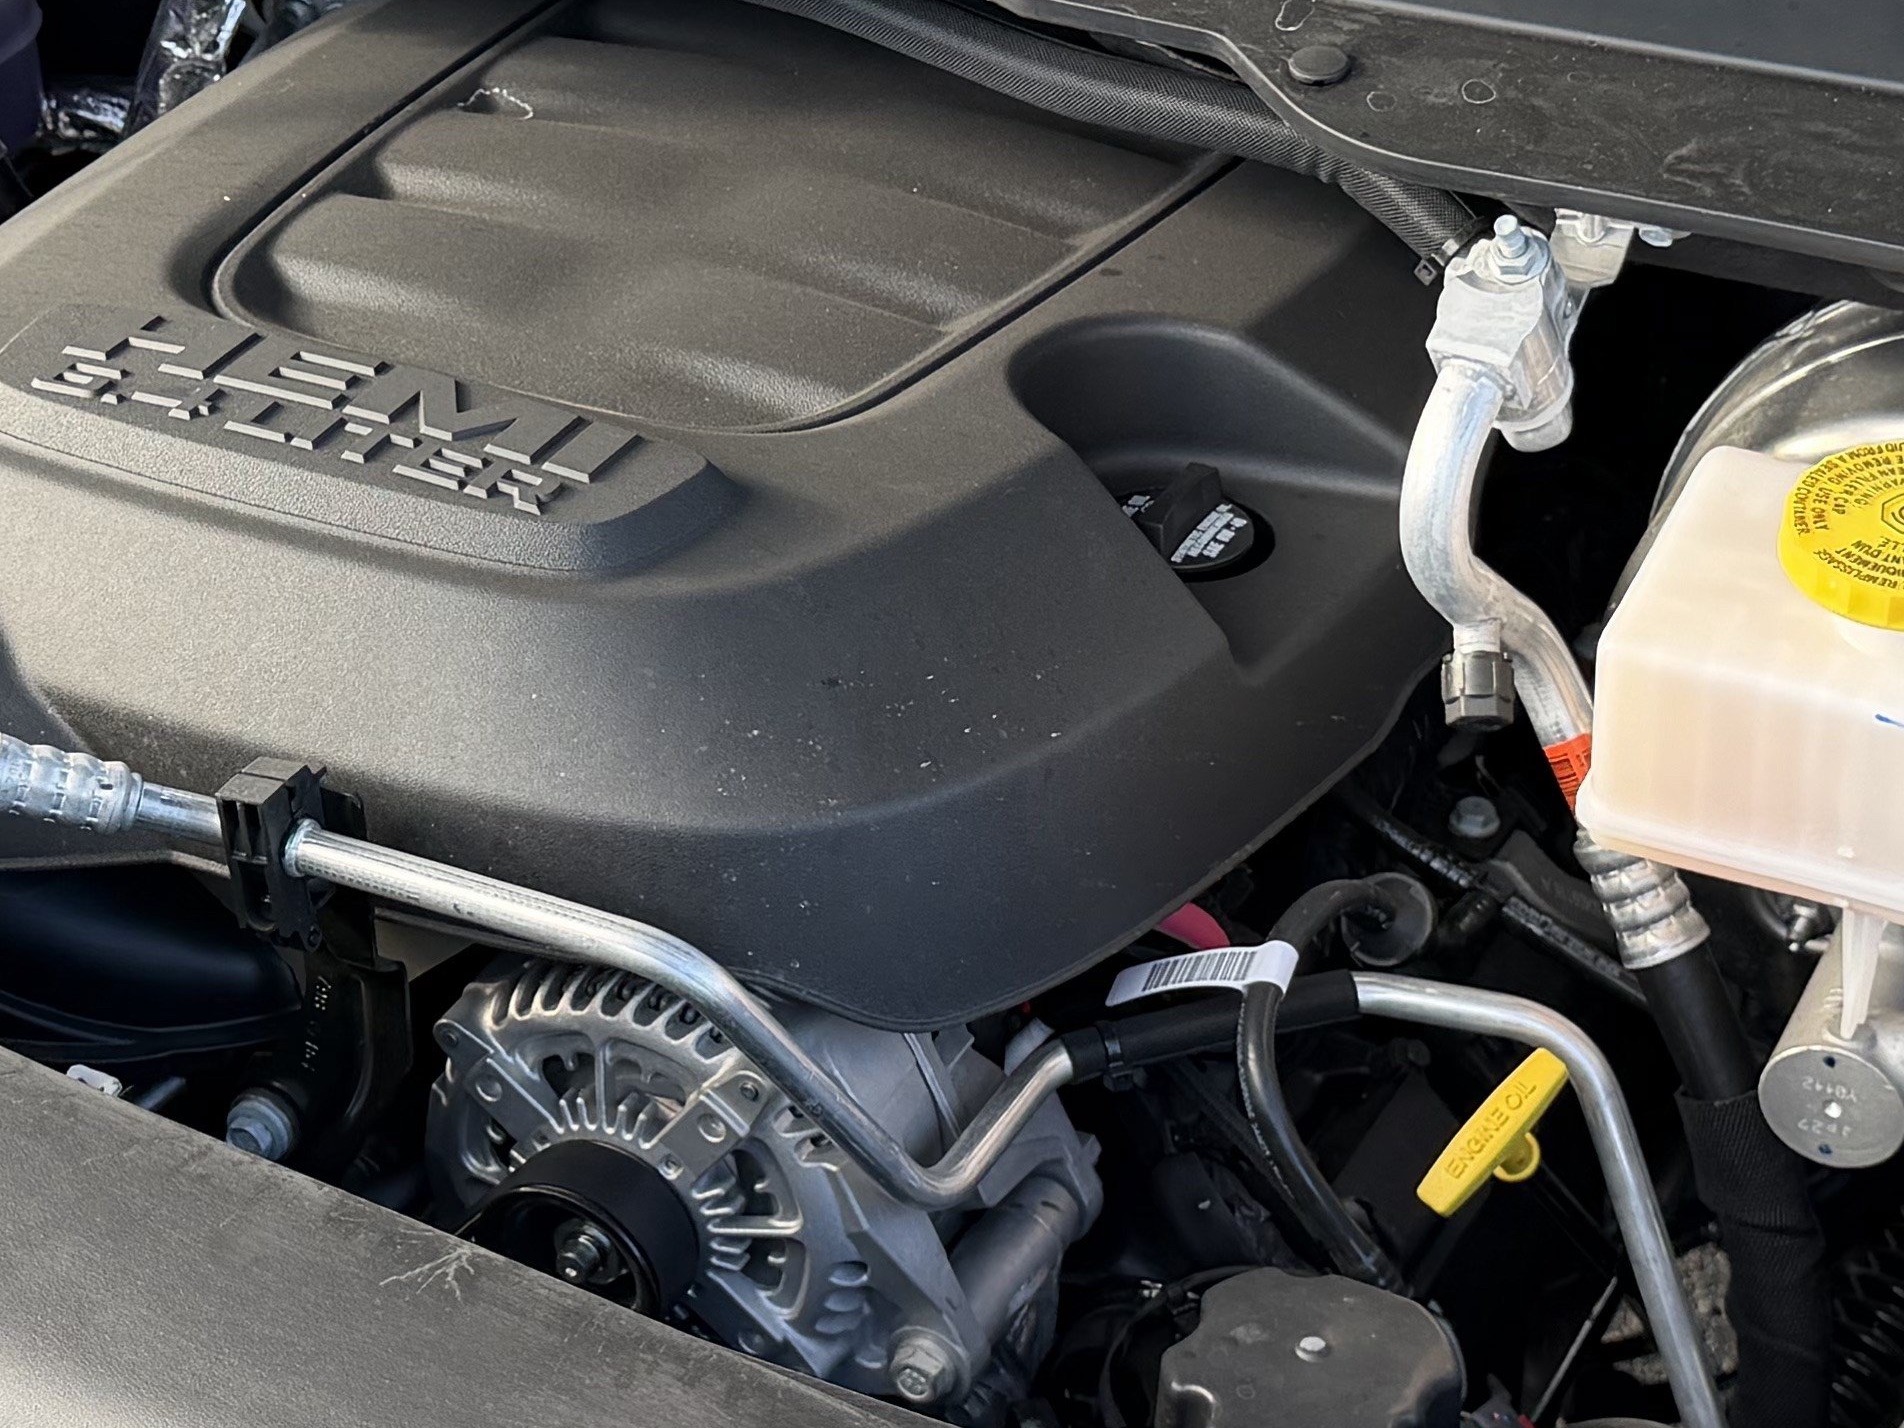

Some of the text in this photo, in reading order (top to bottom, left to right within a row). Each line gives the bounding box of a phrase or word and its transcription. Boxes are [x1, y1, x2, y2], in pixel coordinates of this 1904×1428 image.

[61, 310, 643, 484] HEMI
[222, 398, 571, 518] LITER
[1446, 1080, 1538, 1181] ENGINE OIL
